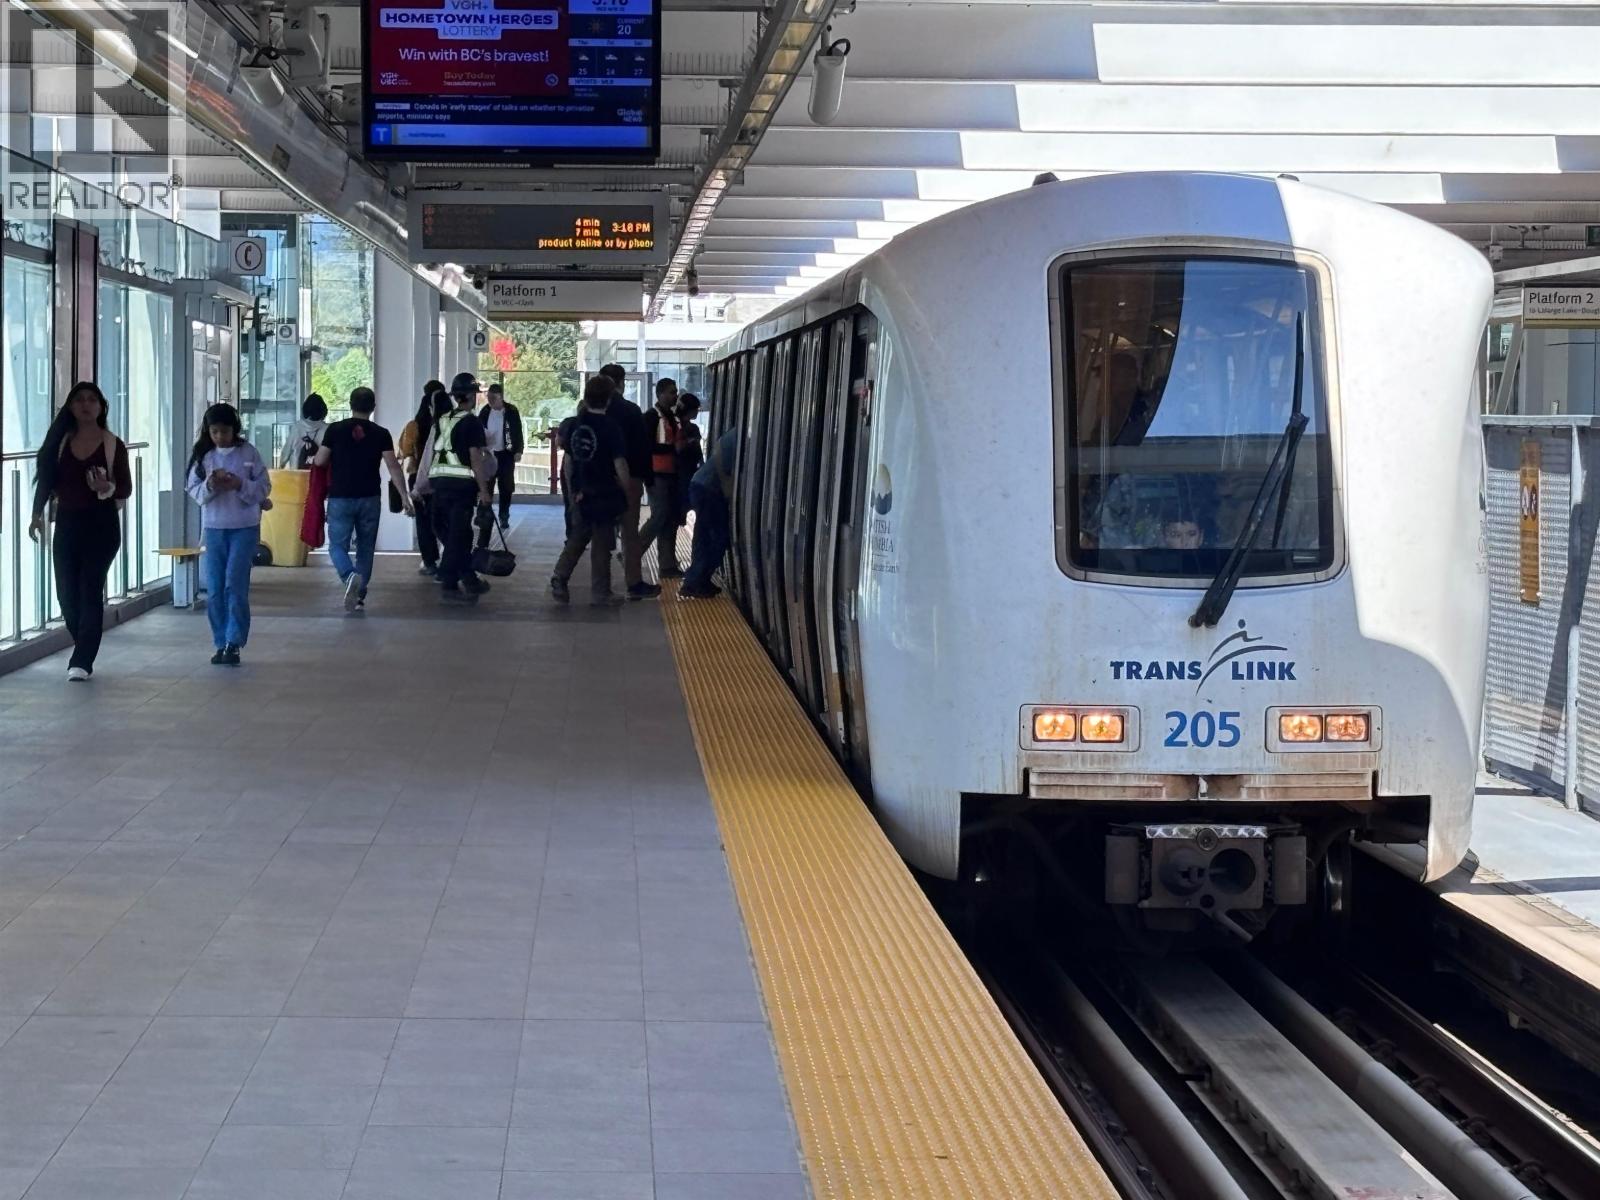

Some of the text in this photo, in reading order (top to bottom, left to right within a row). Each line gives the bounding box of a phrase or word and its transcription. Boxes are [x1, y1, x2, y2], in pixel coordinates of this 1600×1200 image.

[385, 13, 553, 25] HOMETOWN HEROES
[442, 25, 497, 36] LOTTERY
[617, 25, 631, 35] 20
[399, 48, 549, 62] Win with BC's bravest!
[444, 72, 496, 80] Buy Today
[575, 218, 600, 227] 4 min
[636, 222, 650, 232] PM
[575, 228, 600, 237] 7 min
[539, 238, 572, 249] product
[575, 238, 602, 248] online
[605, 239, 613, 247] or
[616, 238, 627, 249] by
[493, 284, 557, 297] Platform 1
[1529, 291, 1594, 304] Platform 2
[1163, 710, 1241, 748] 205
